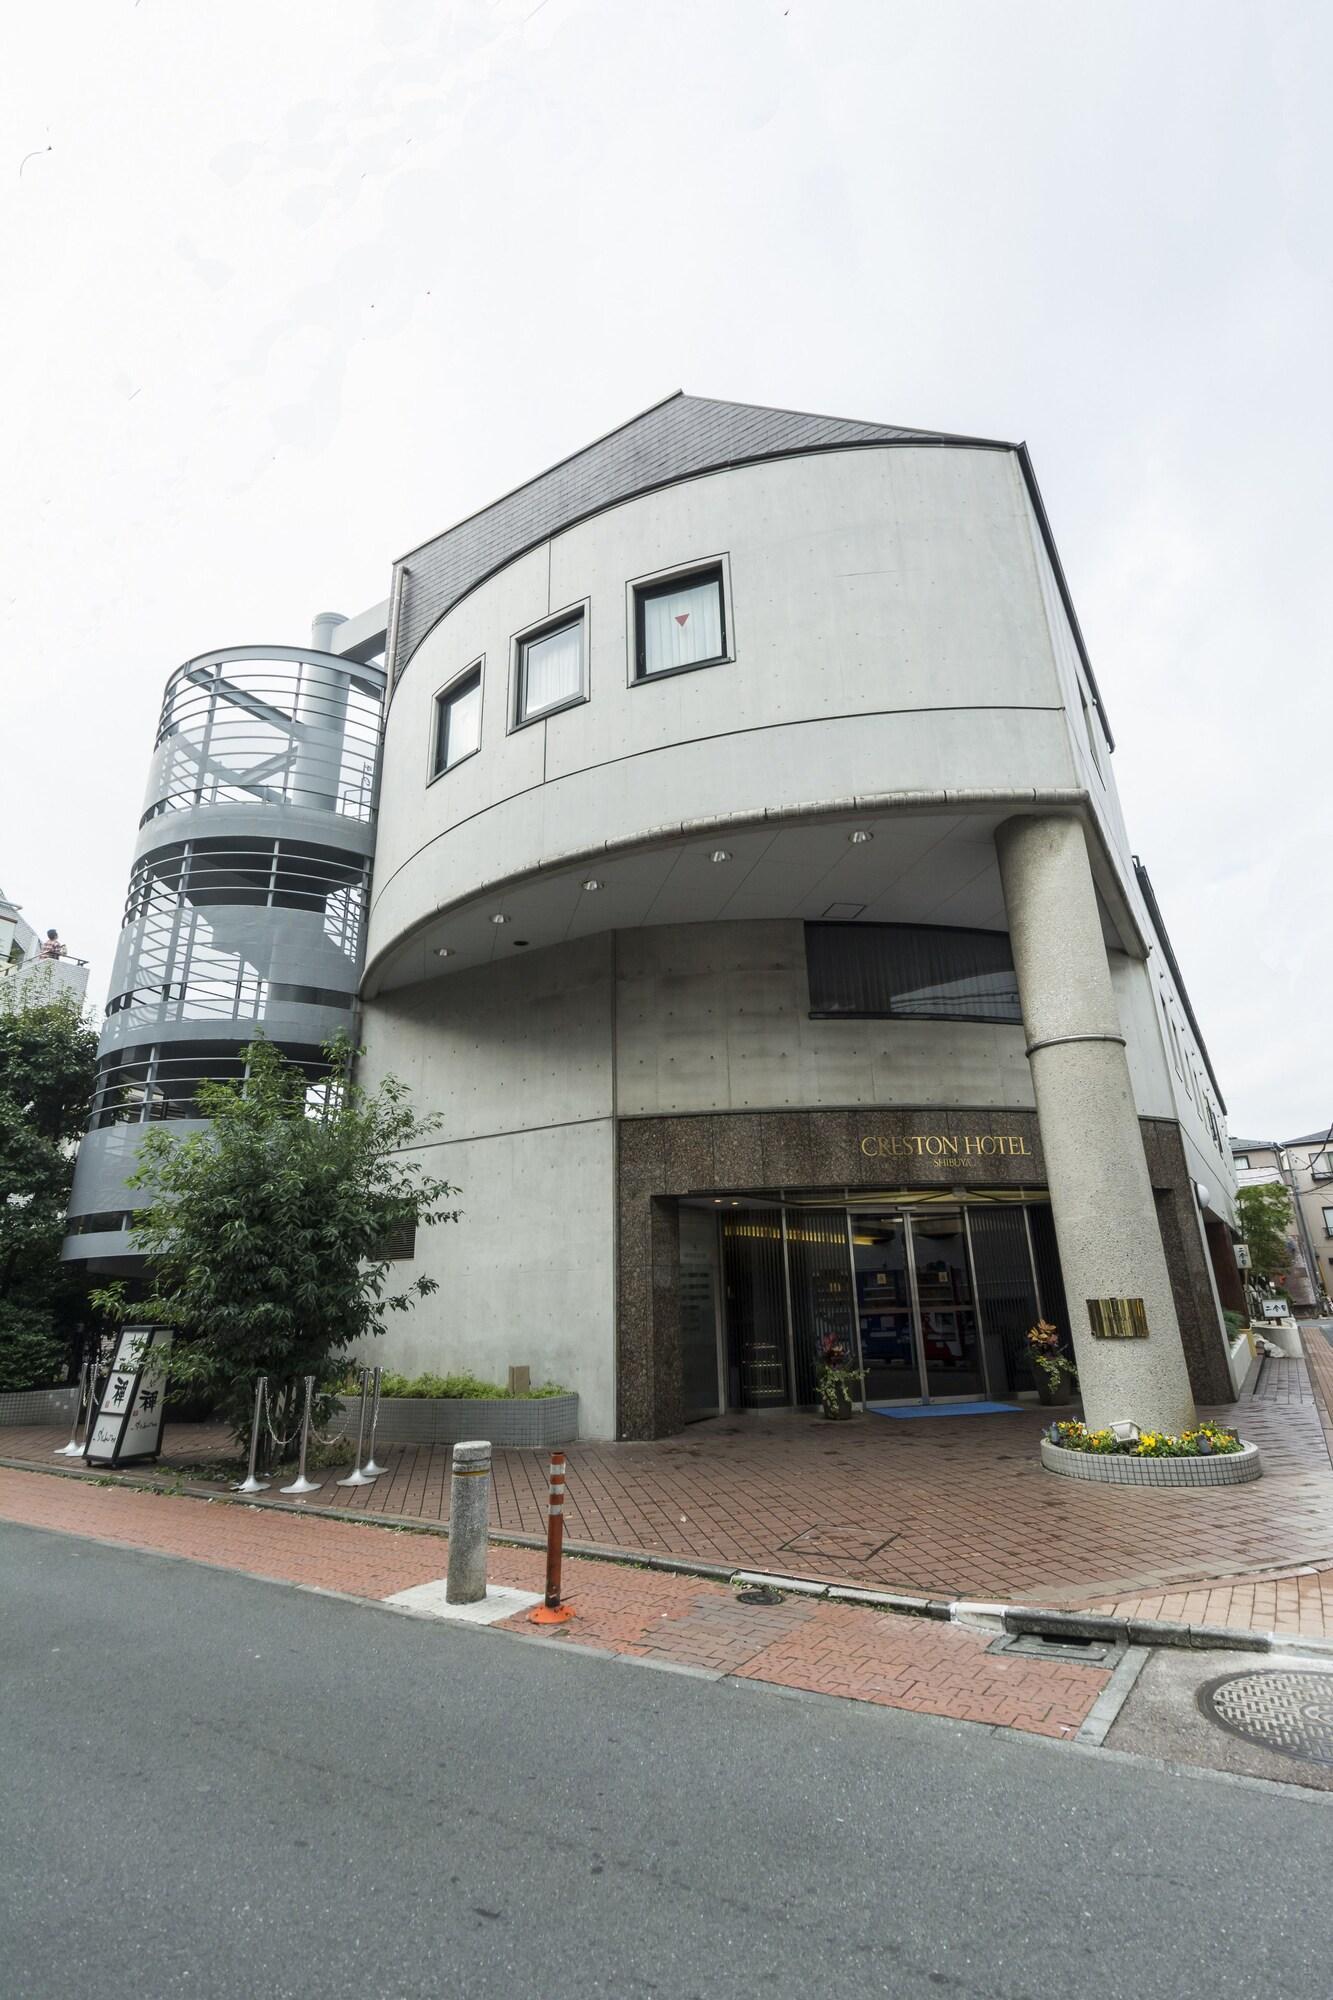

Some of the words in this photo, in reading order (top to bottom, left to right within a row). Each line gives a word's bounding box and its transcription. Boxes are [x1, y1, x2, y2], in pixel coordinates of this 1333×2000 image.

[861, 1135, 958, 1157] CRESTON
[965, 1135, 1032, 1156] HOTEL
[933, 1157, 972, 1168] SHIBUYA
